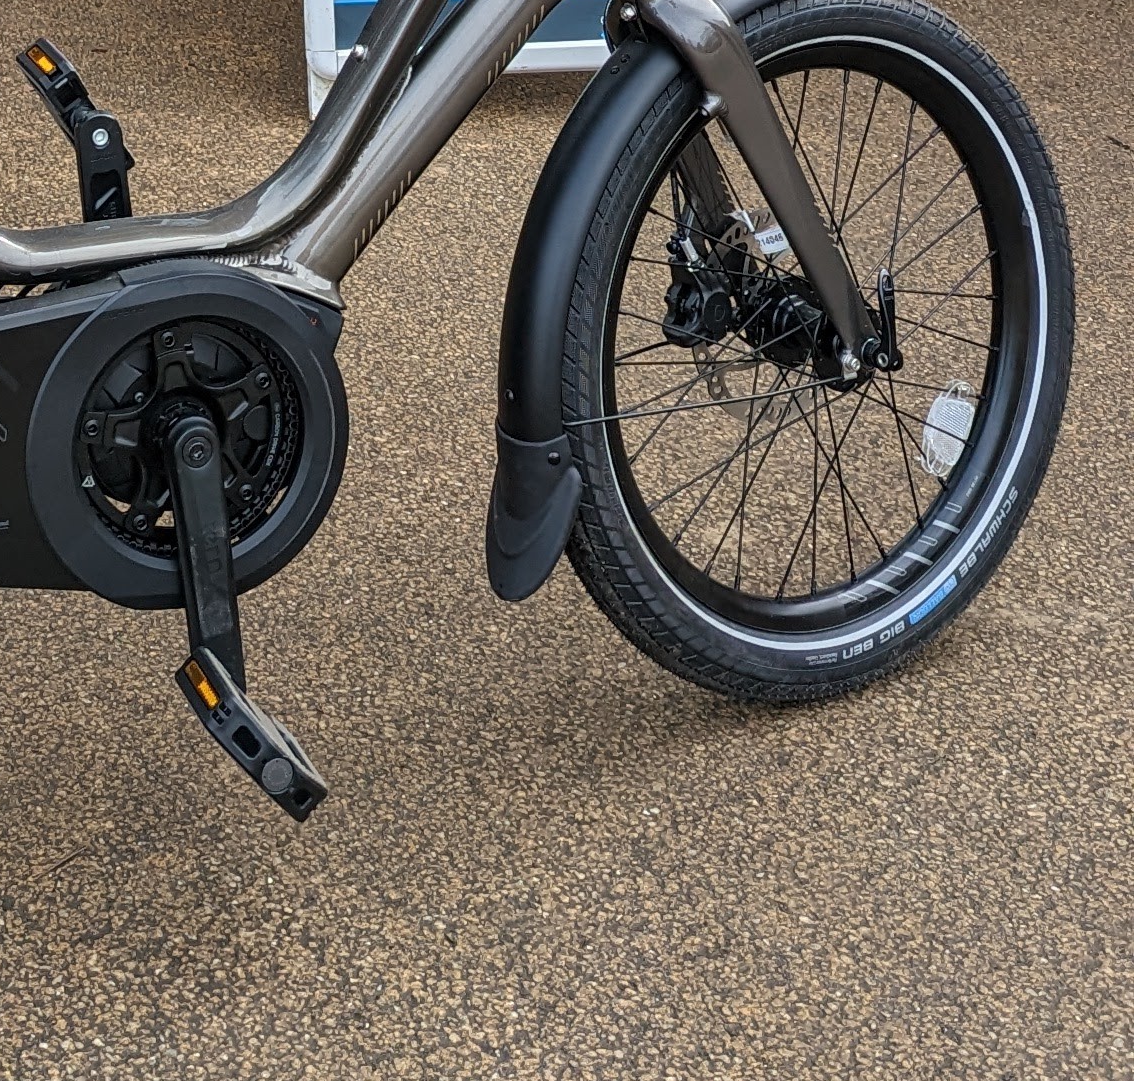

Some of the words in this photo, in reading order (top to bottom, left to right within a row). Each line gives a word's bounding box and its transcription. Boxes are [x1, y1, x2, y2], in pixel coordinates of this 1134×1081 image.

[958, 486, 1019, 578] SCHWALBE
[879, 620, 906, 644] BIG
[842, 640, 874, 660] BEN
